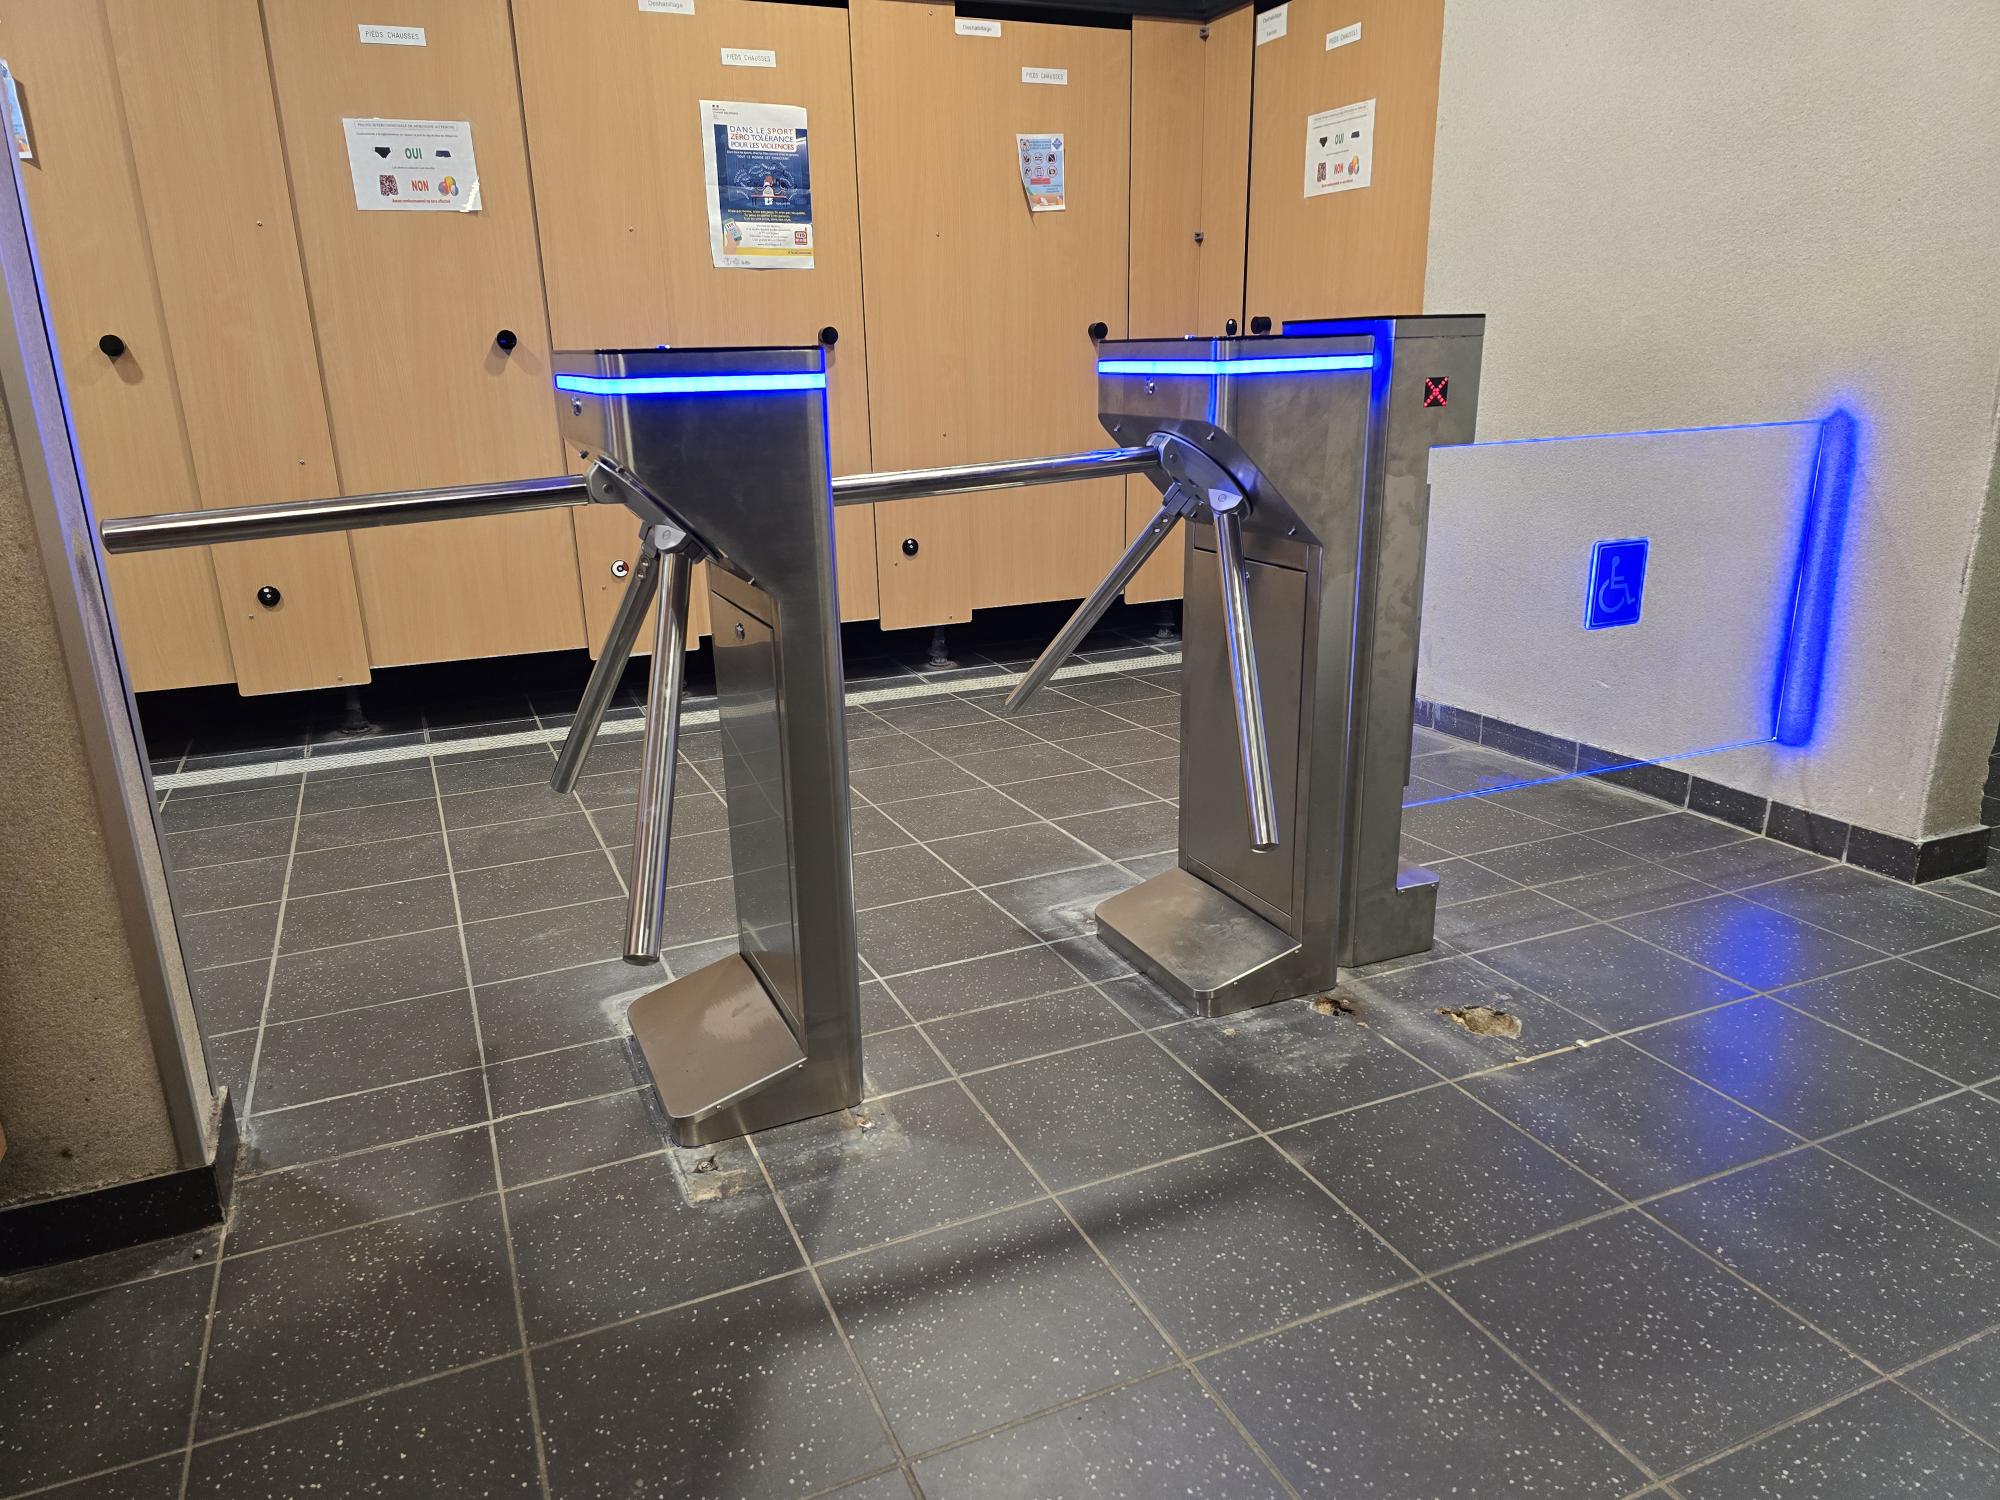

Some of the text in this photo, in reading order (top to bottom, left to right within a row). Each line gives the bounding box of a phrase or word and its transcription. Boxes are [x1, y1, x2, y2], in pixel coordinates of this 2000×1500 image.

[365, 30, 420, 40] PIEDS CHAUSSES
[730, 133, 793, 142] ZÉRO TOLÉRANCE
[1334, 133, 1345, 145] OUI
[404, 147, 423, 160] OUI
[1333, 163, 1344, 175] NON
[411, 180, 429, 191] NON
